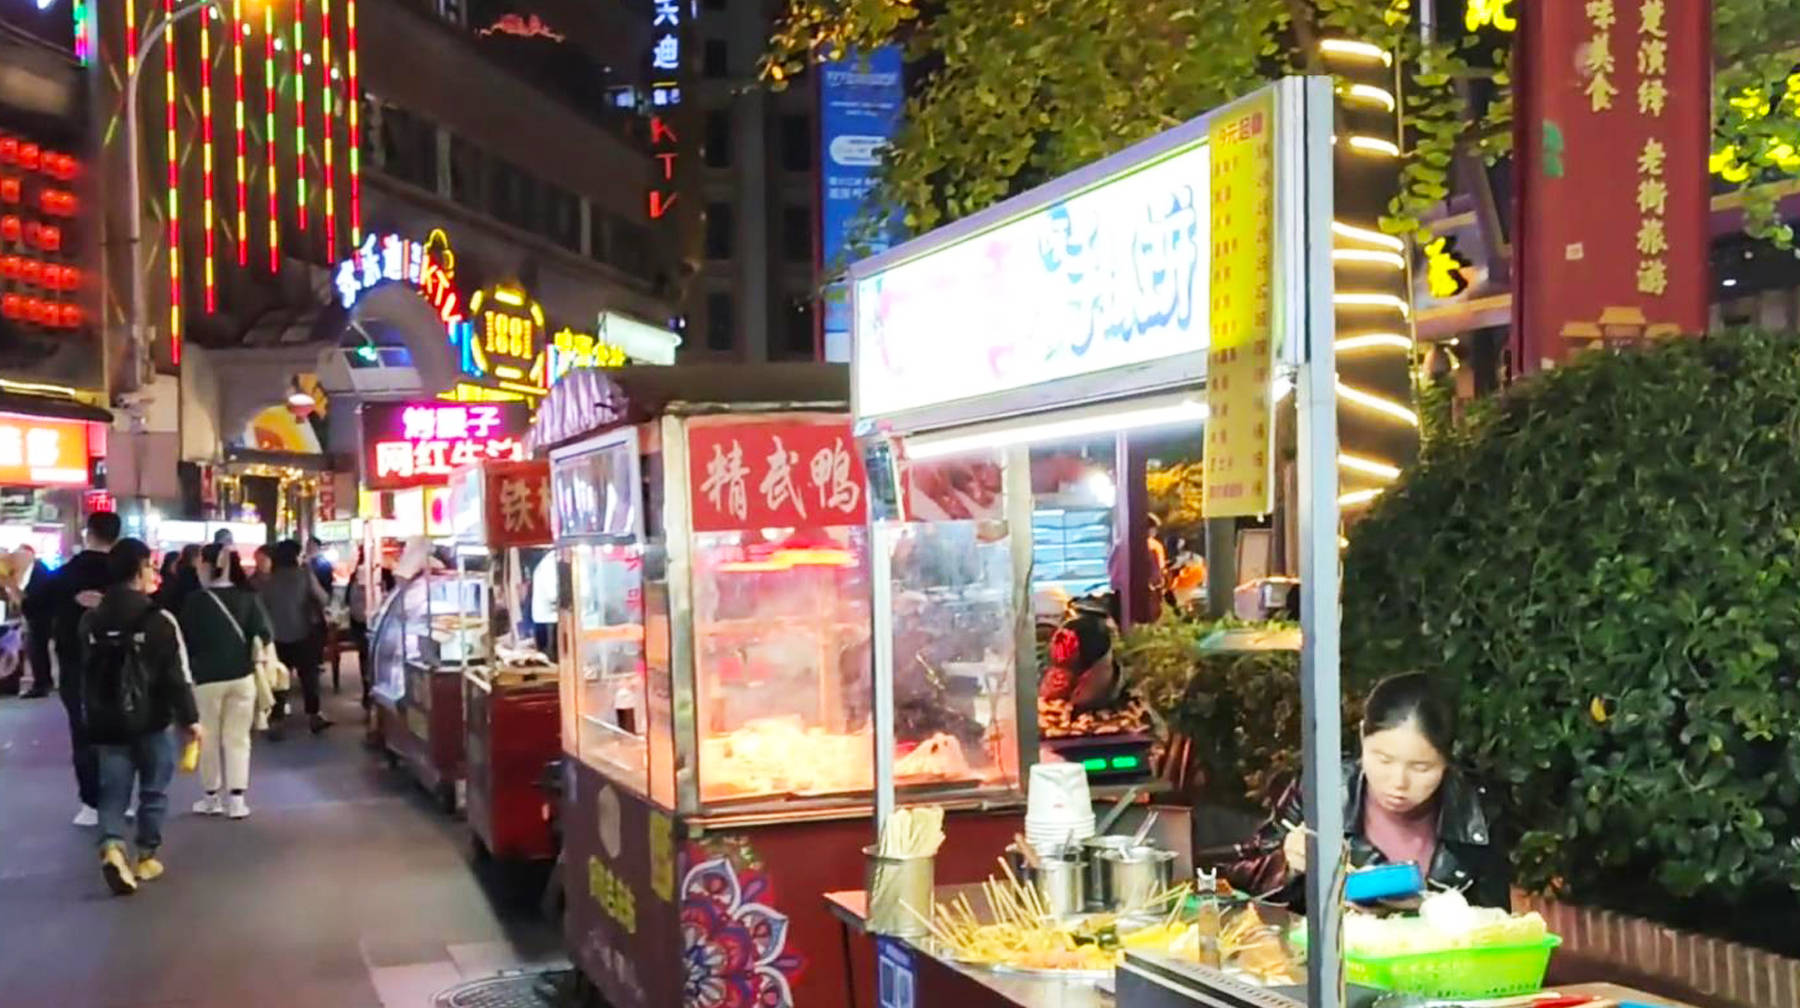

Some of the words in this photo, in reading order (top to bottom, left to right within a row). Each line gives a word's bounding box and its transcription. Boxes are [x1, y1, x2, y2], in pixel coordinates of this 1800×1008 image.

[650, 116, 678, 219] KTV
[1636, 136, 1669, 295] 老街旅游
[420, 254, 462, 323] KTV
[700, 434, 860, 521] 精武鸭
